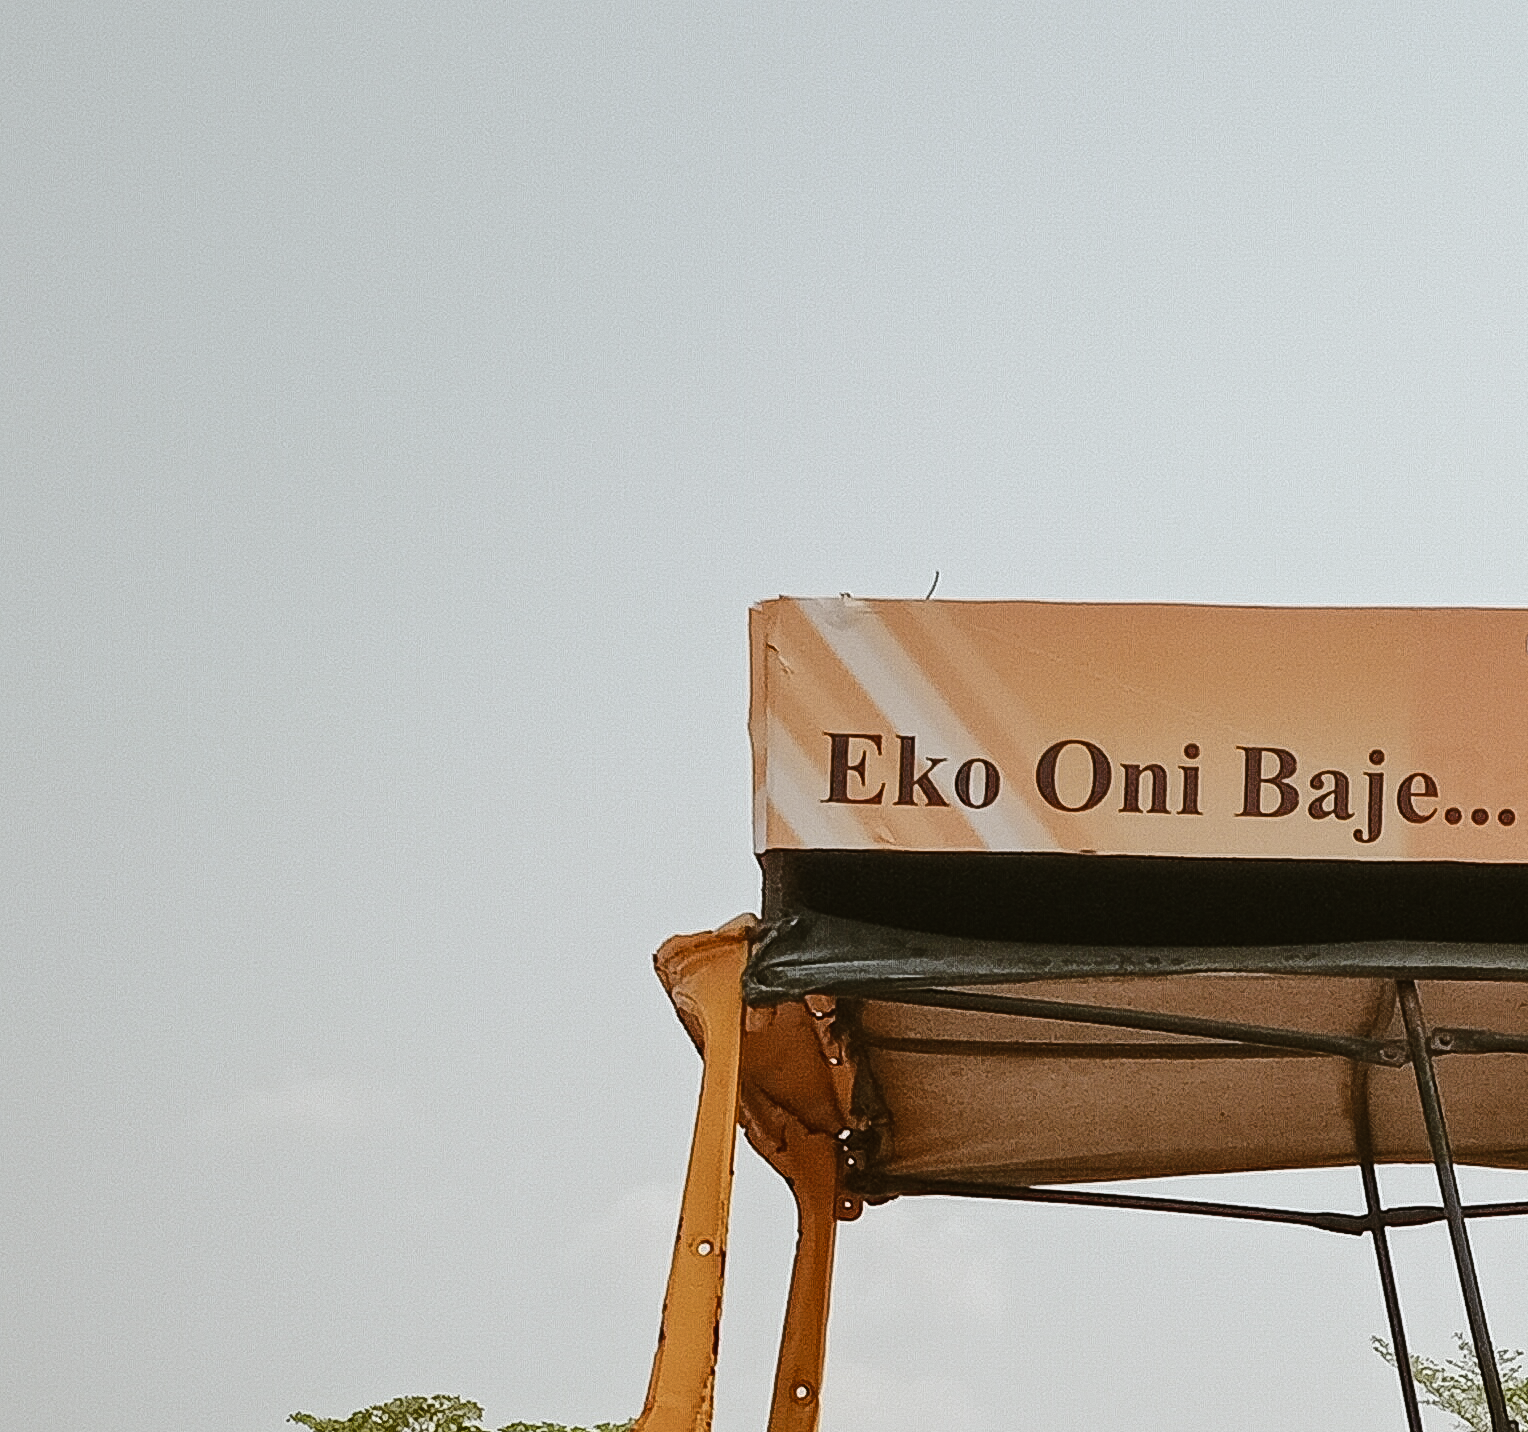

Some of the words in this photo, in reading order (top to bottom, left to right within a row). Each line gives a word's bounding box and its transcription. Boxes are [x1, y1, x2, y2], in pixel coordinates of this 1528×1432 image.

[820, 731, 1001, 810] Eko
[1035, 738, 1204, 817] Oni
[1234, 742, 1516, 844] Baje...
